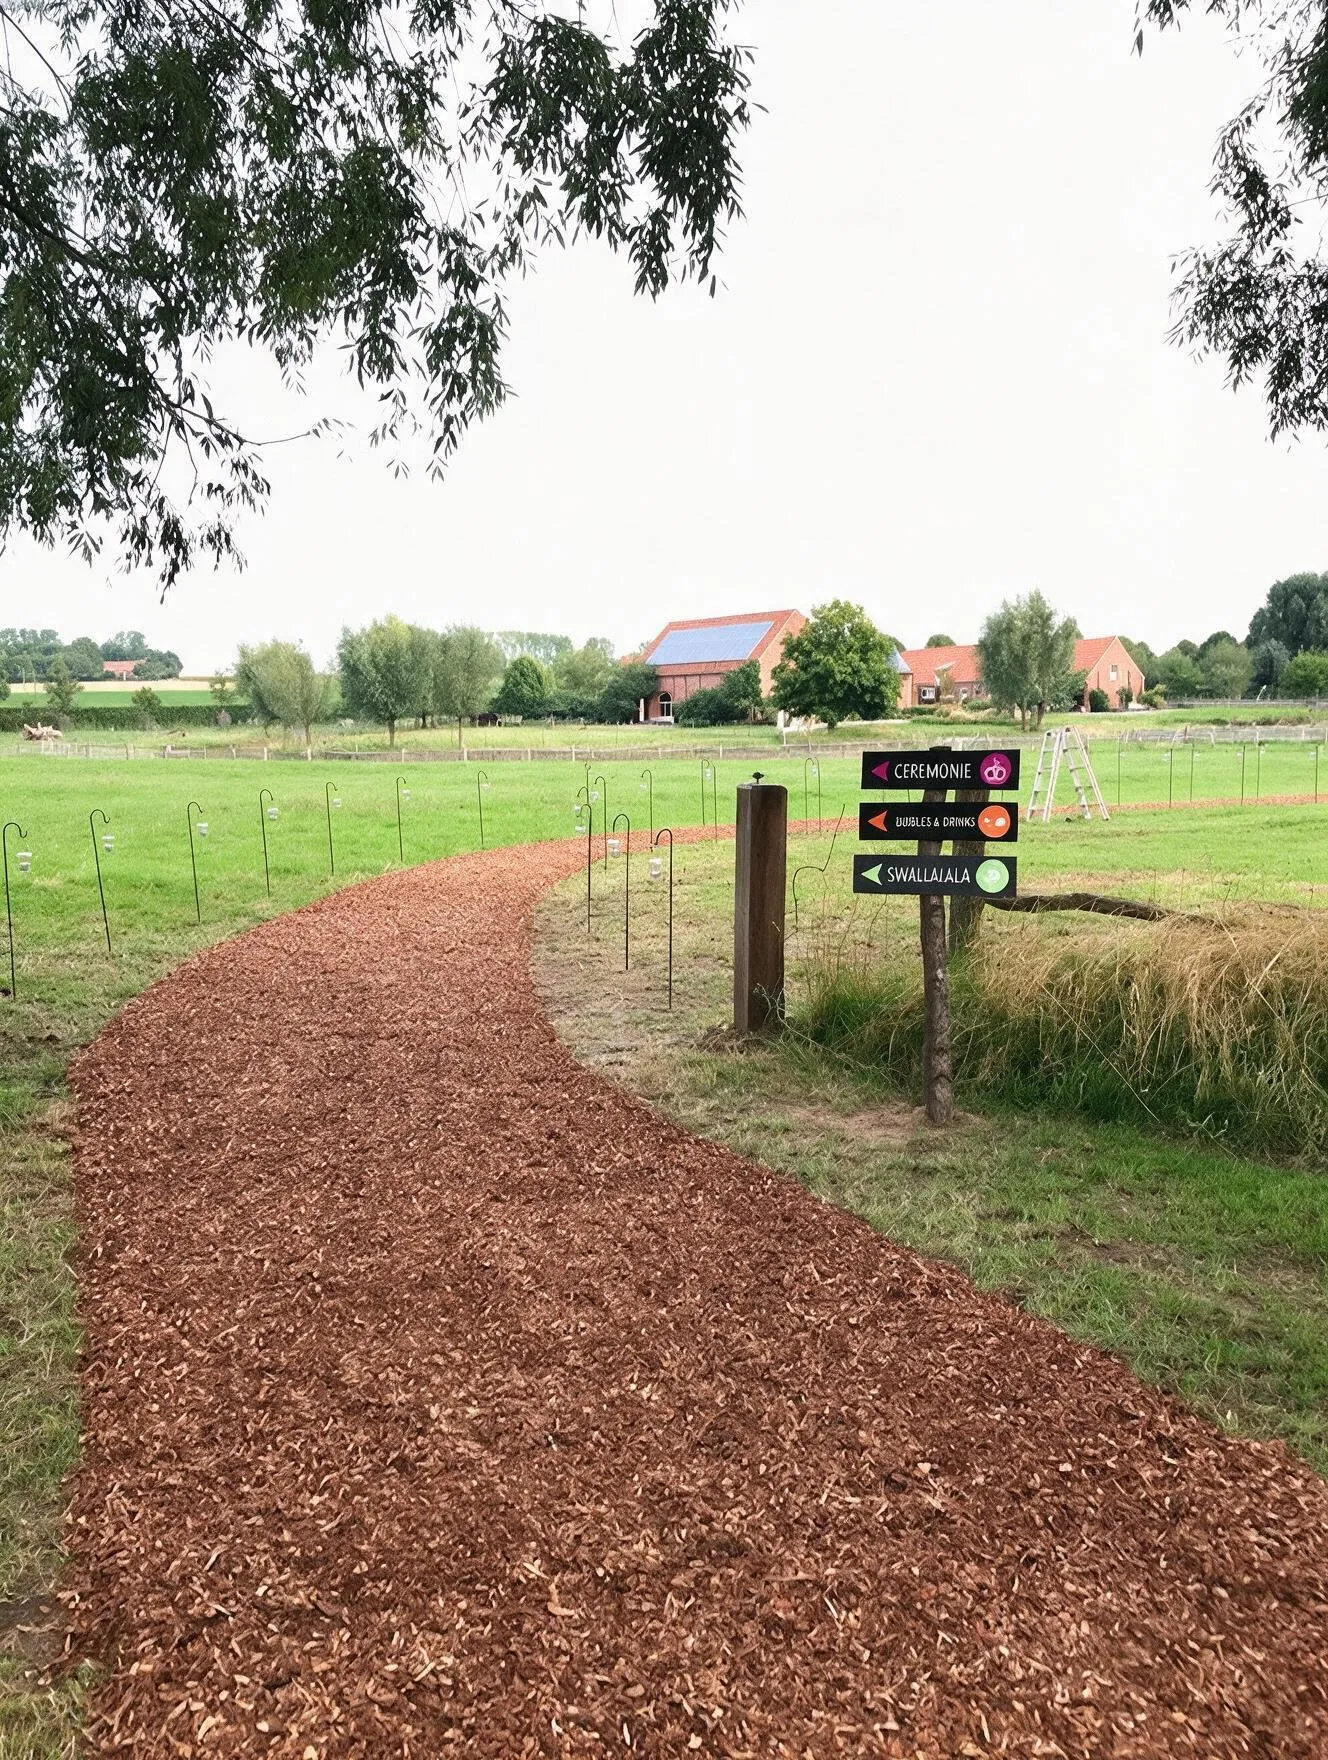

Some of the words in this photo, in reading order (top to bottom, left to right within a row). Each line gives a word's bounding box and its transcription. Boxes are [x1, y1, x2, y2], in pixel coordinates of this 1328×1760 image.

[894, 763, 972, 779] CEREMONIE
[934, 817, 940, 827] &
[943, 816, 976, 828] DRINKS
